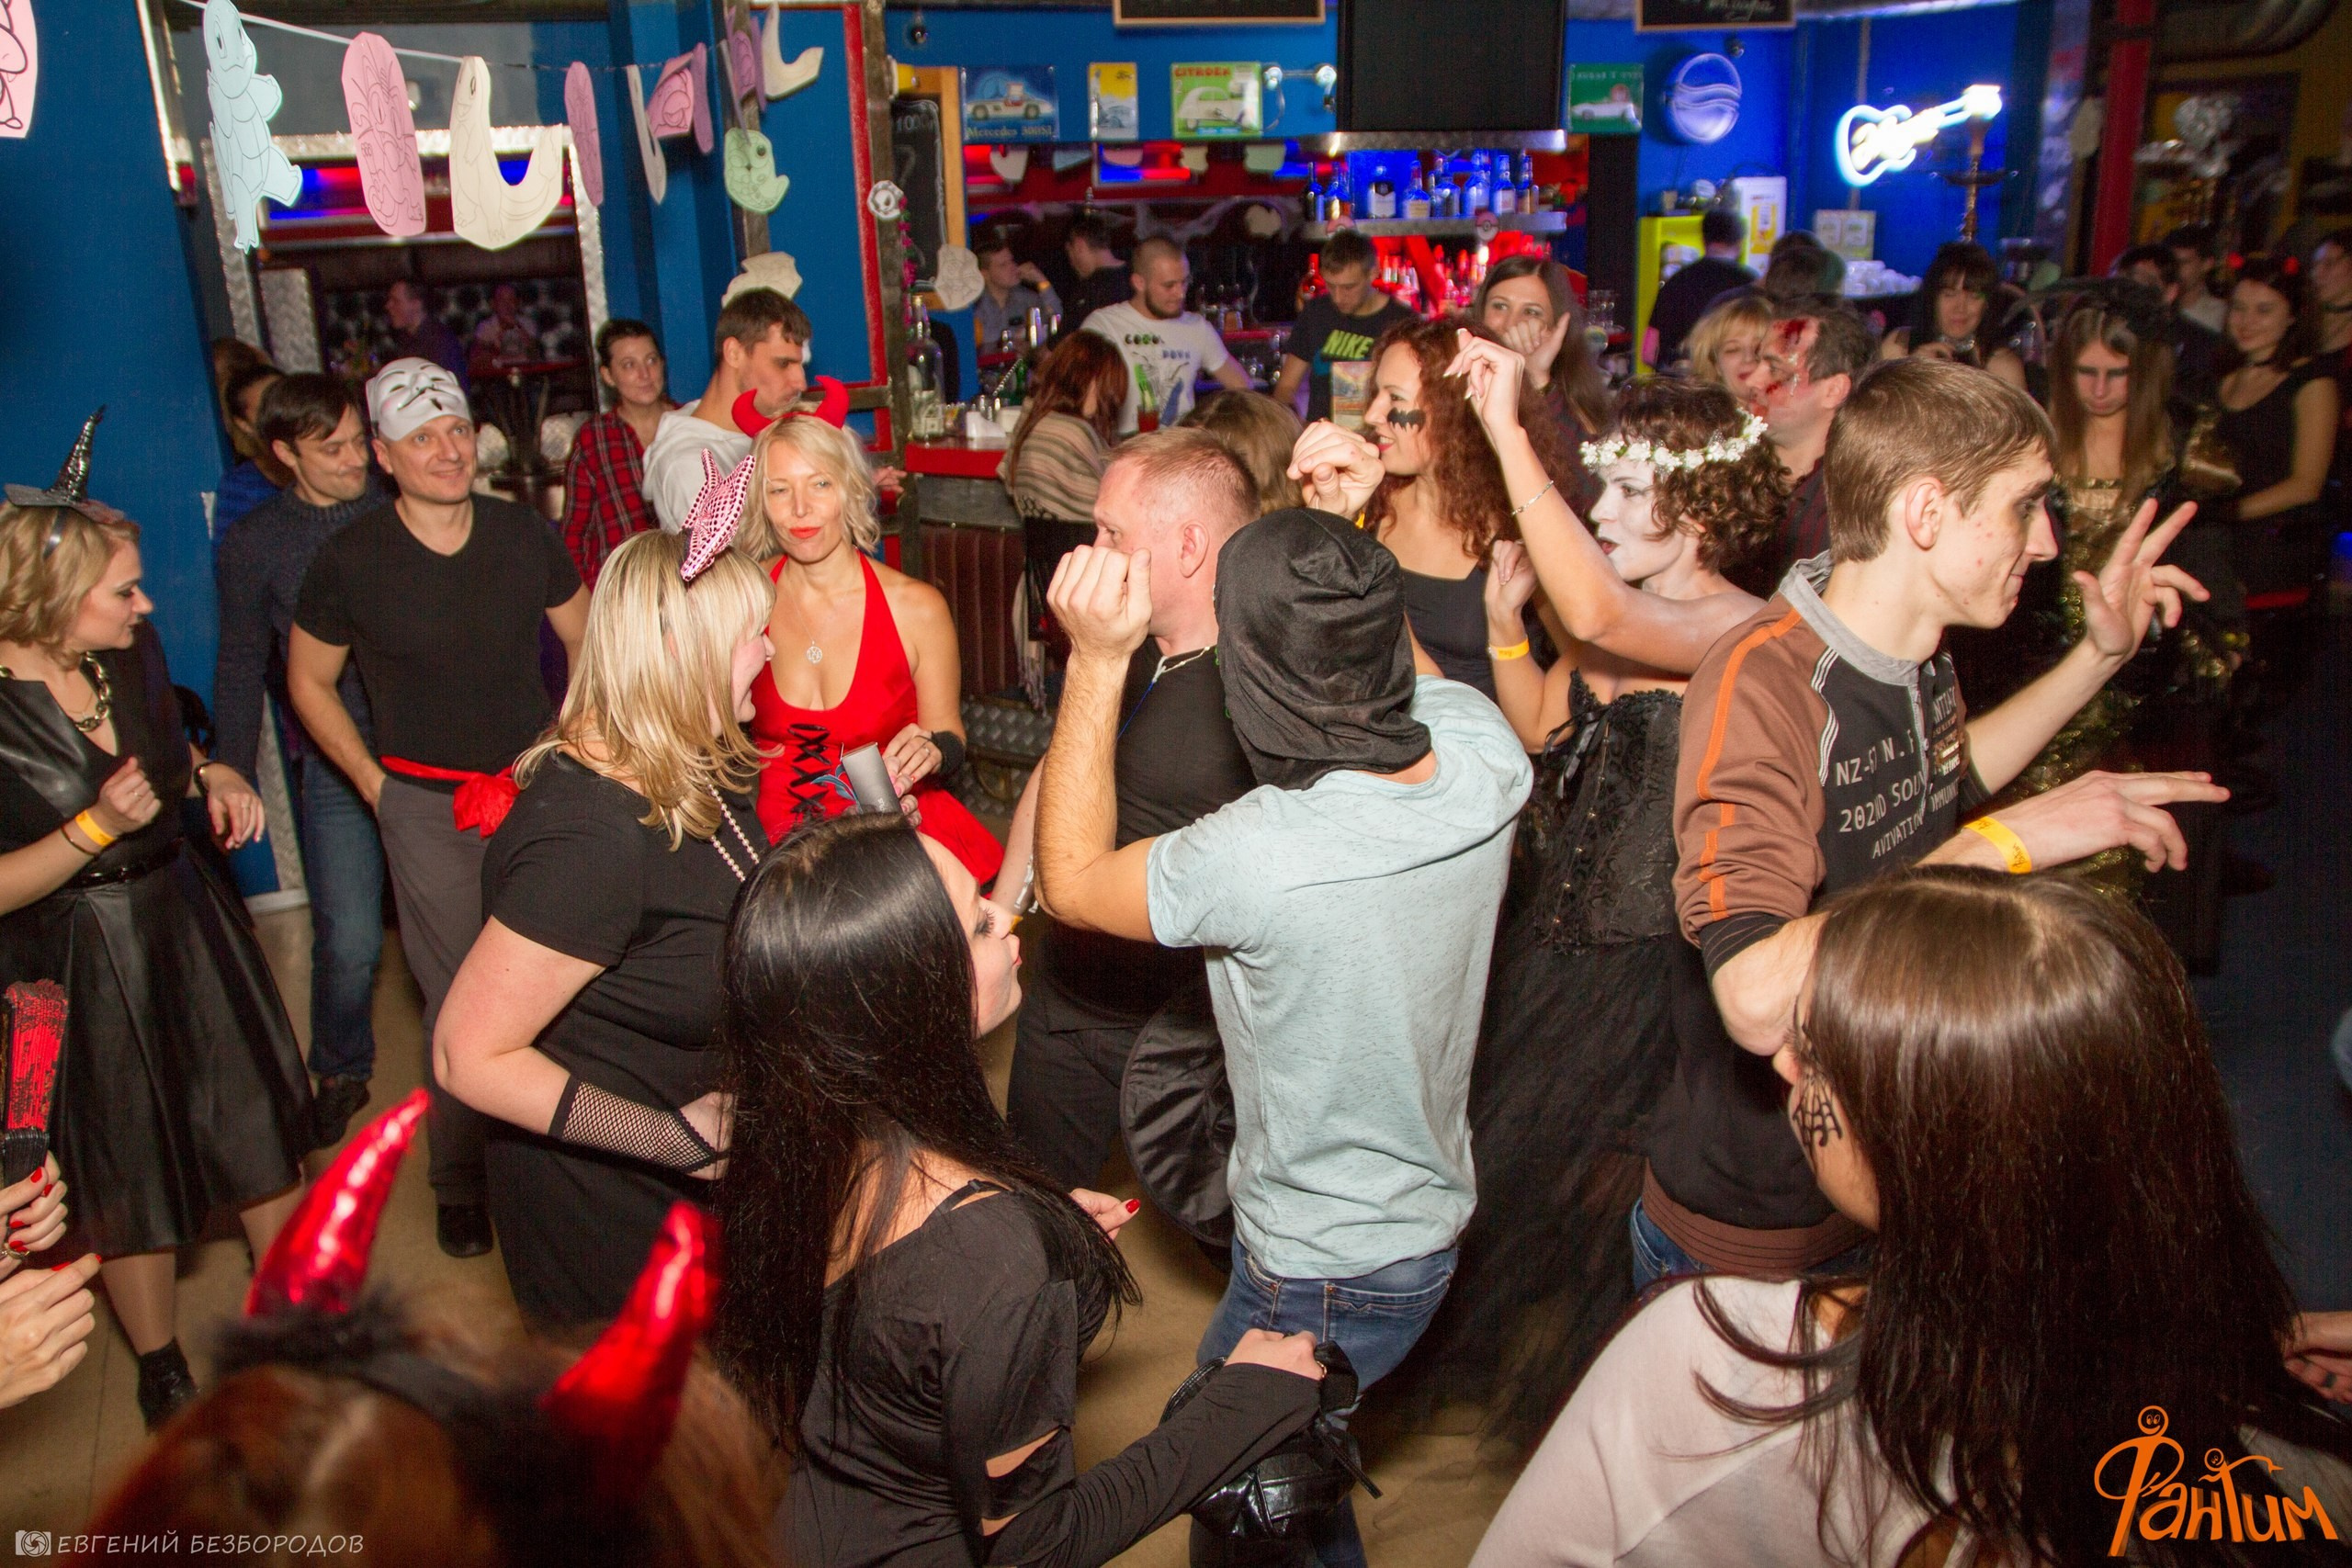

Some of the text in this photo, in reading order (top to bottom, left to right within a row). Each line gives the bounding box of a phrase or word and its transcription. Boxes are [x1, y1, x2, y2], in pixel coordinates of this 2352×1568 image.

[967, 126, 1018, 139] Mercedes
[1321, 329, 1374, 359] NIKE
[1839, 793, 1887, 833] 202ND
